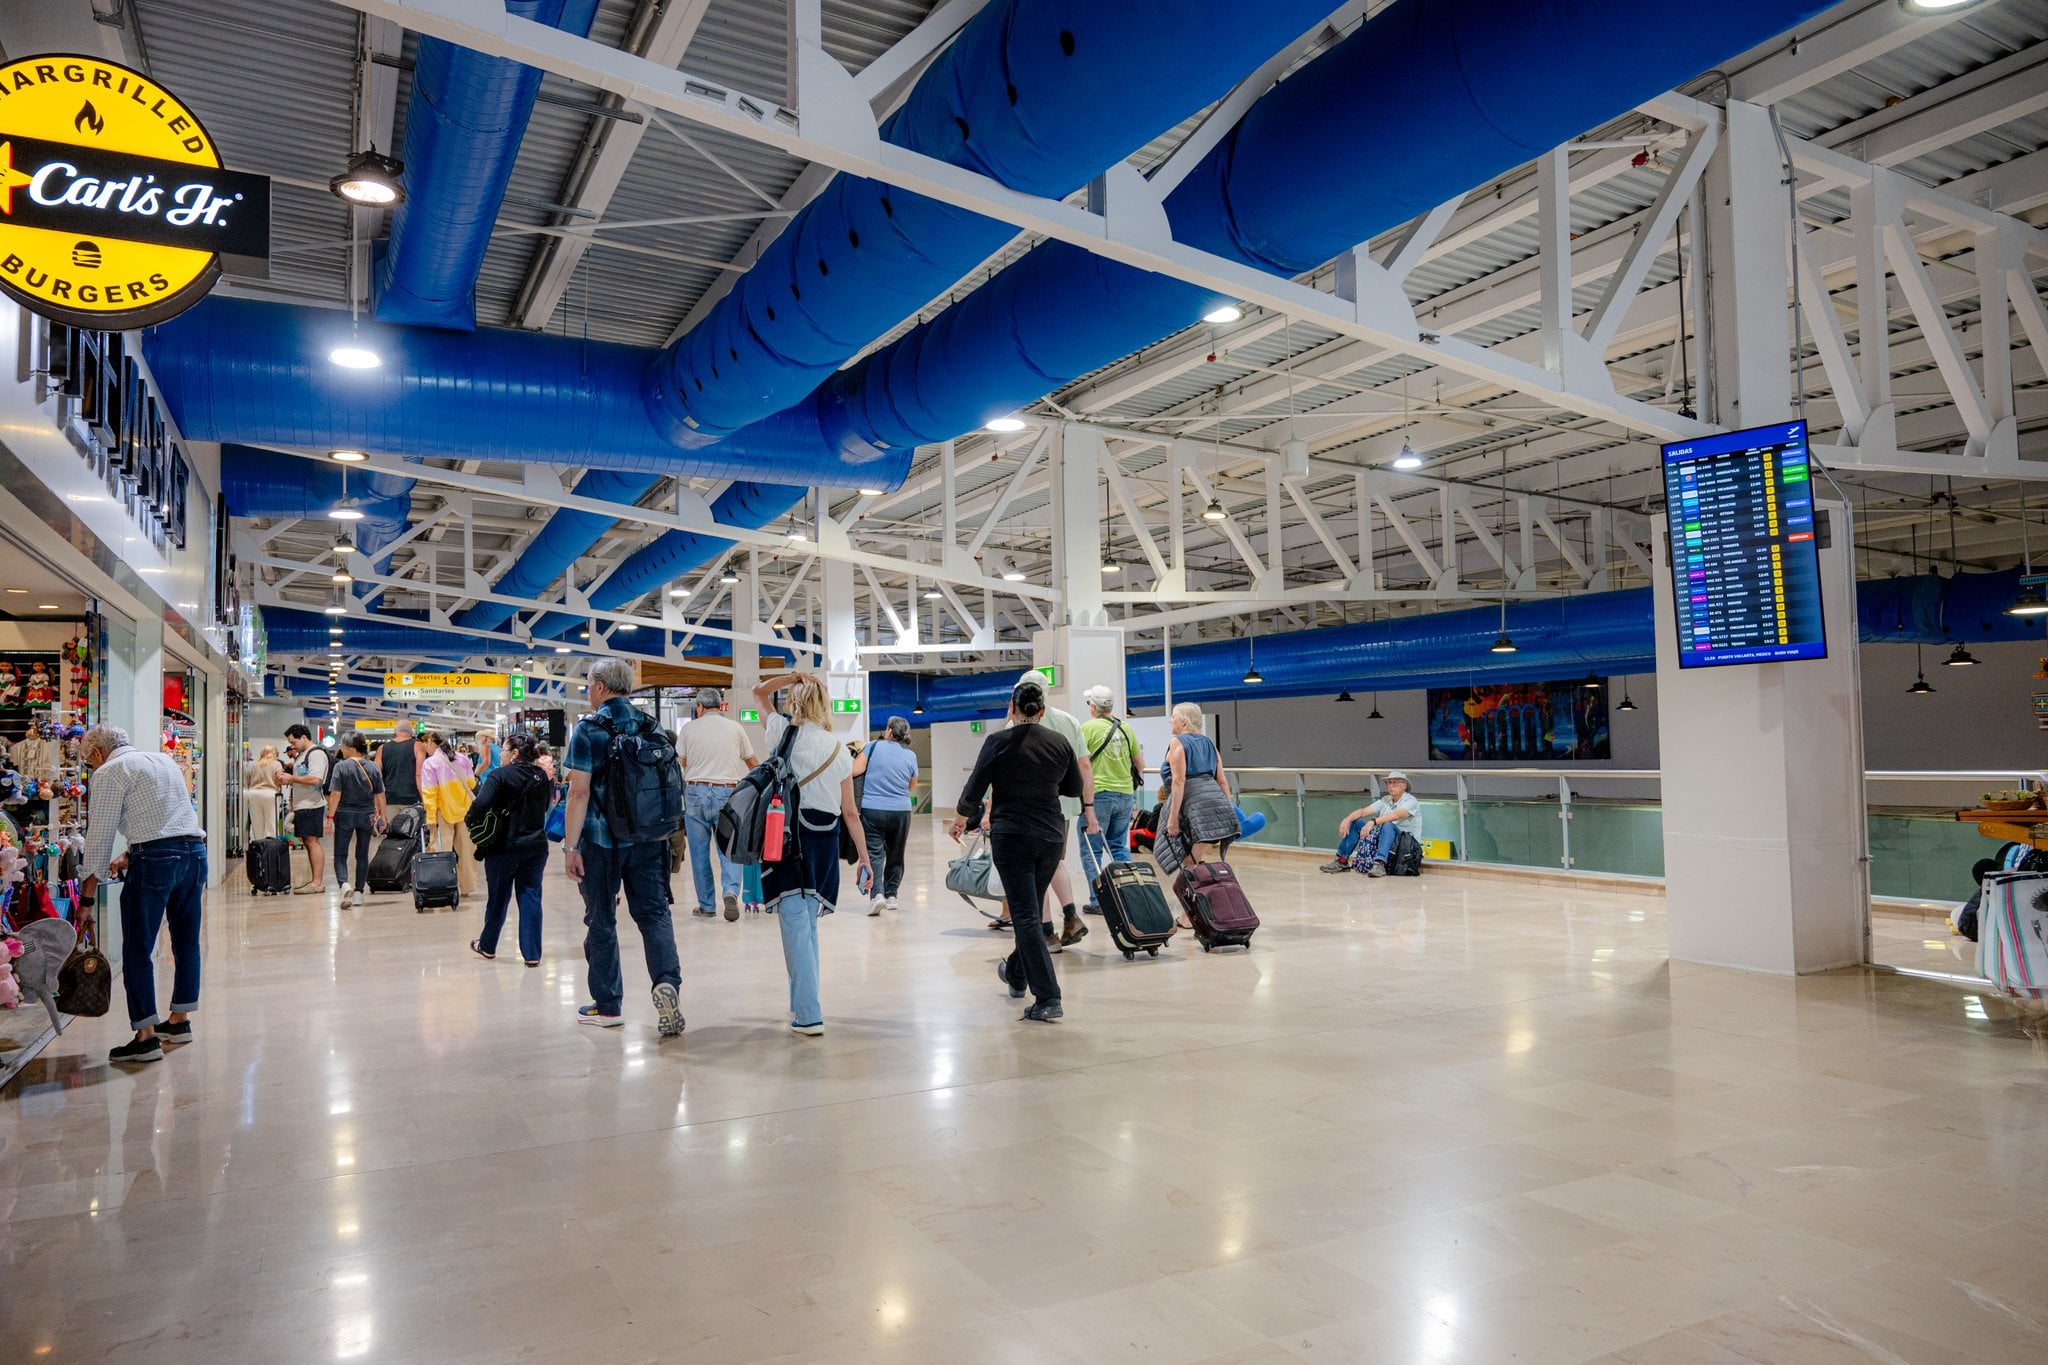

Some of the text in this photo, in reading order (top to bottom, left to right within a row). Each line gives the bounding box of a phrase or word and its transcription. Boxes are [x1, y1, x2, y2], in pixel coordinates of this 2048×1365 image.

[0, 64, 204, 154] ARGRILLED
[28, 162, 165, 215] Carl's
[1, 253, 169, 303] BURGERS
[1668, 448, 1692, 457] SALIDAS
[443, 676, 470, 685] 1-20
